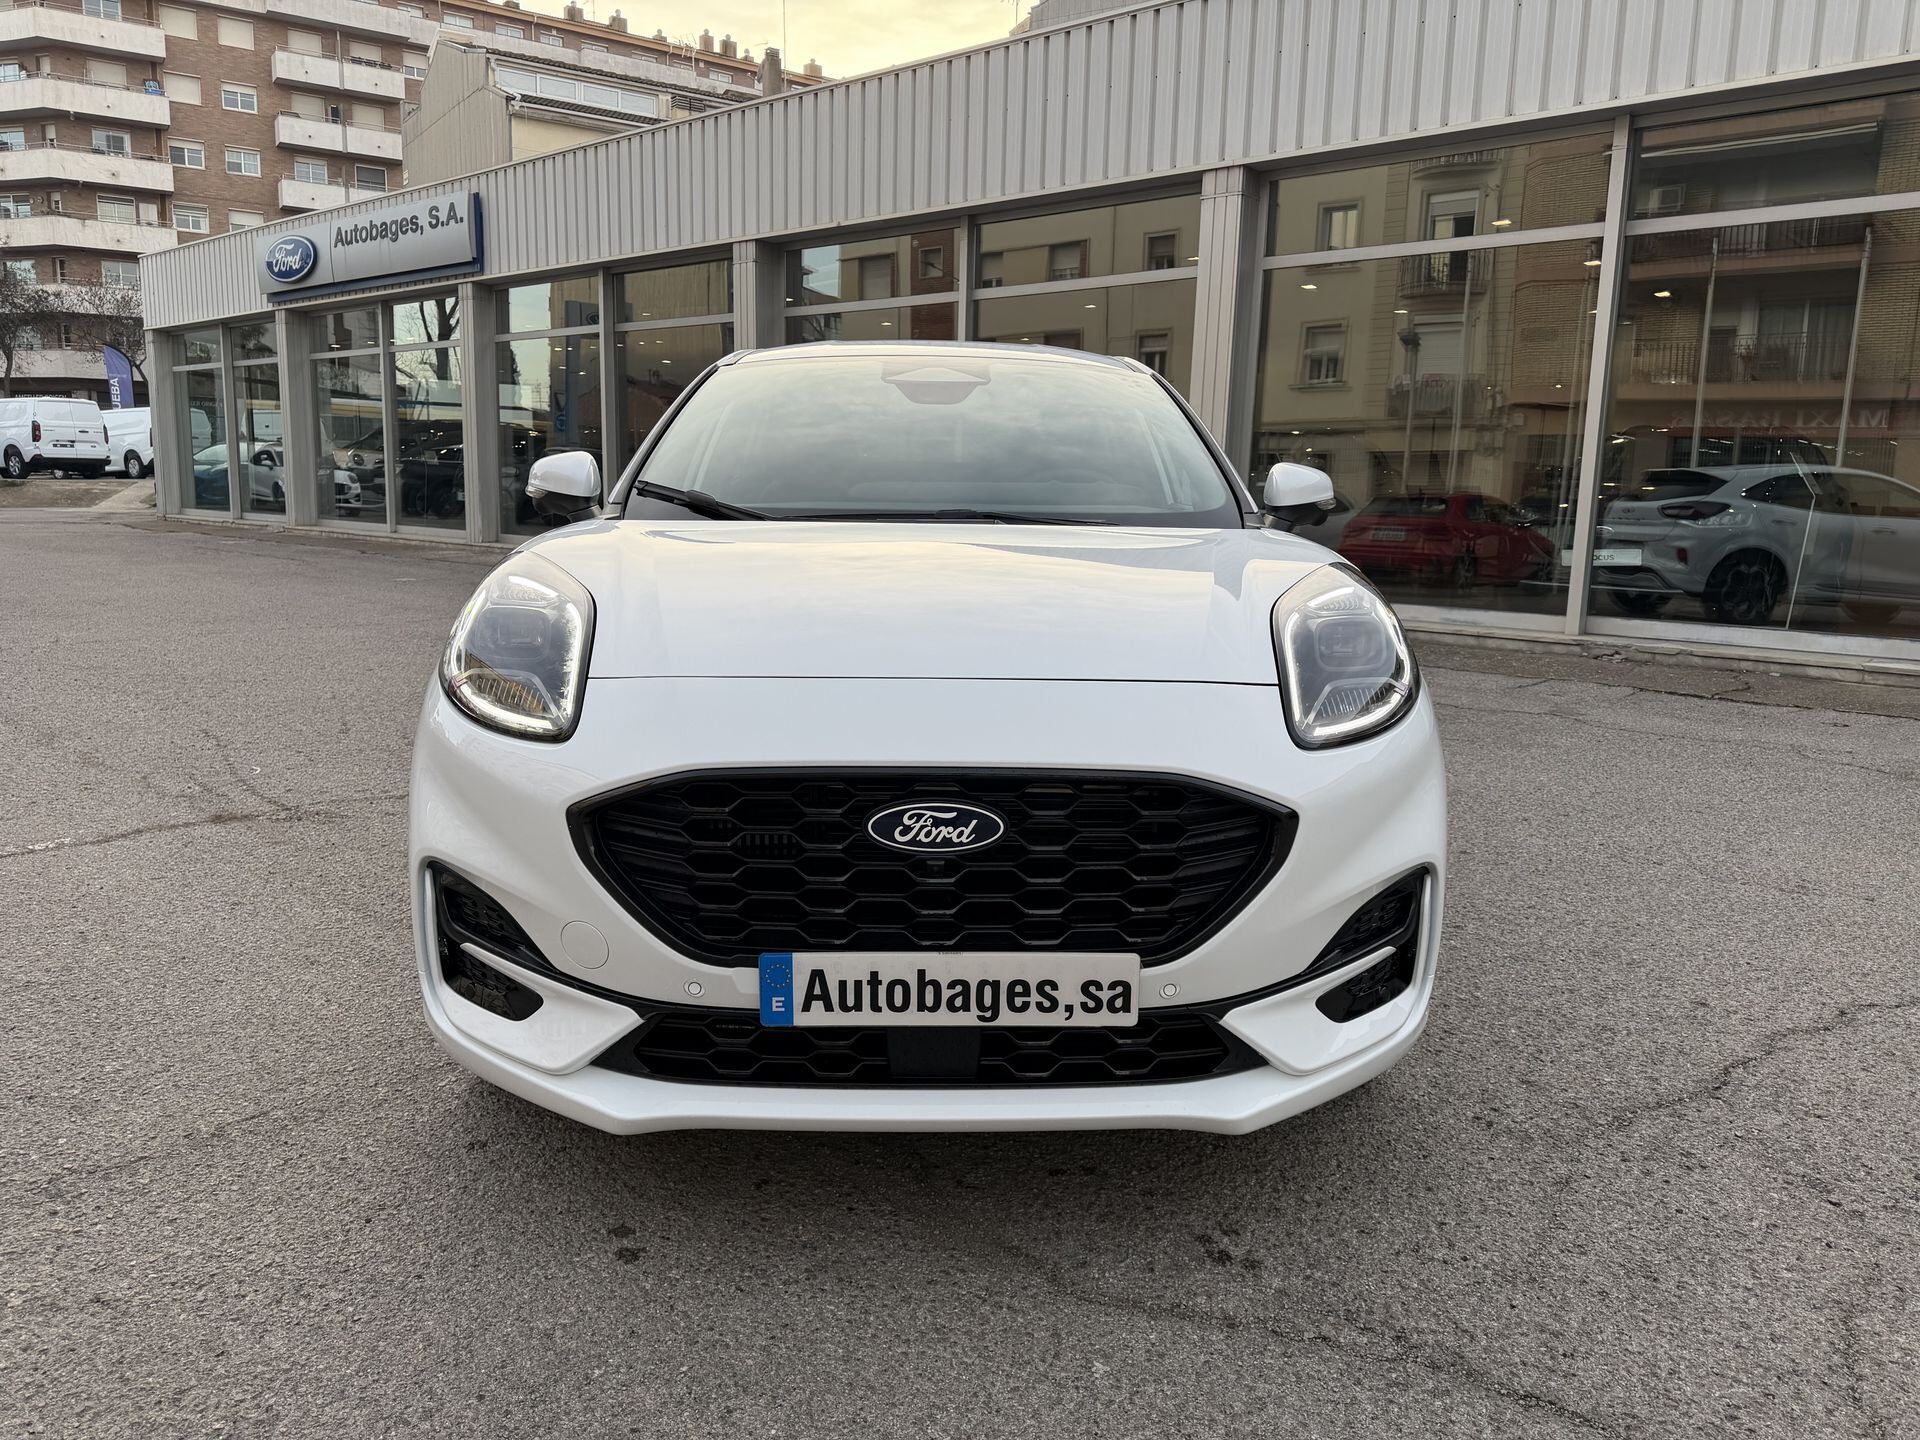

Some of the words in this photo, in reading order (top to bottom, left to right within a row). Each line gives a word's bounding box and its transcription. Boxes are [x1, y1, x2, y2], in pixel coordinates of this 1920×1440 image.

[334, 214, 425, 248] Autobages,
[427, 201, 465, 230] S.A.
[273, 243, 303, 273] Ford
[893, 809, 978, 843] Ford
[771, 996, 785, 1012] E
[800, 968, 1132, 1023] Autobages,sa
